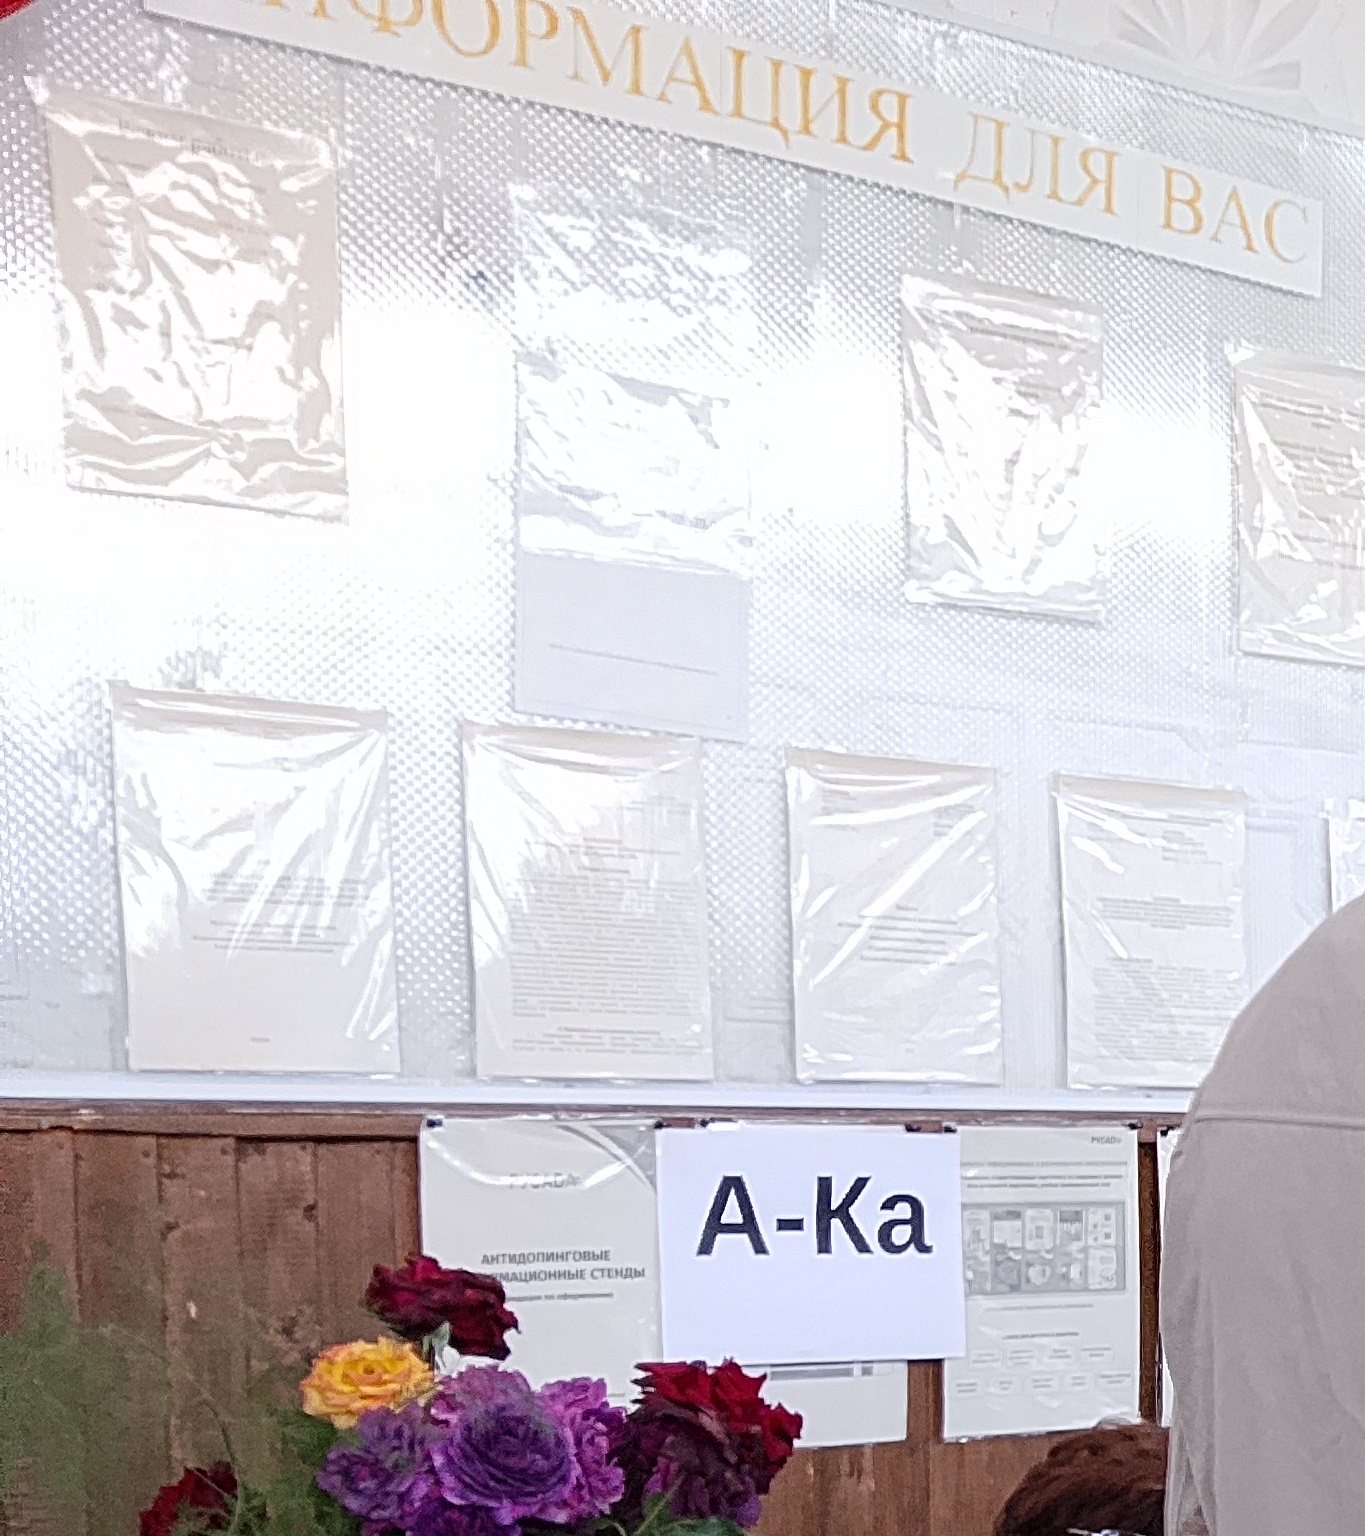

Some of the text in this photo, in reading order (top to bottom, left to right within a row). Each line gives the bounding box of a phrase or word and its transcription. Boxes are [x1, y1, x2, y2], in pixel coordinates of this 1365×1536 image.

[264, 0, 1308, 264] ОРМАЦИЯ ДЛЯ ВАС
[696, 1174, 933, 1257] А-Ка
[481, 1250, 611, 1265] АНТИДОПИНГОВЫЕ
[590, 1267, 645, 1280] СТЕНДЫ
